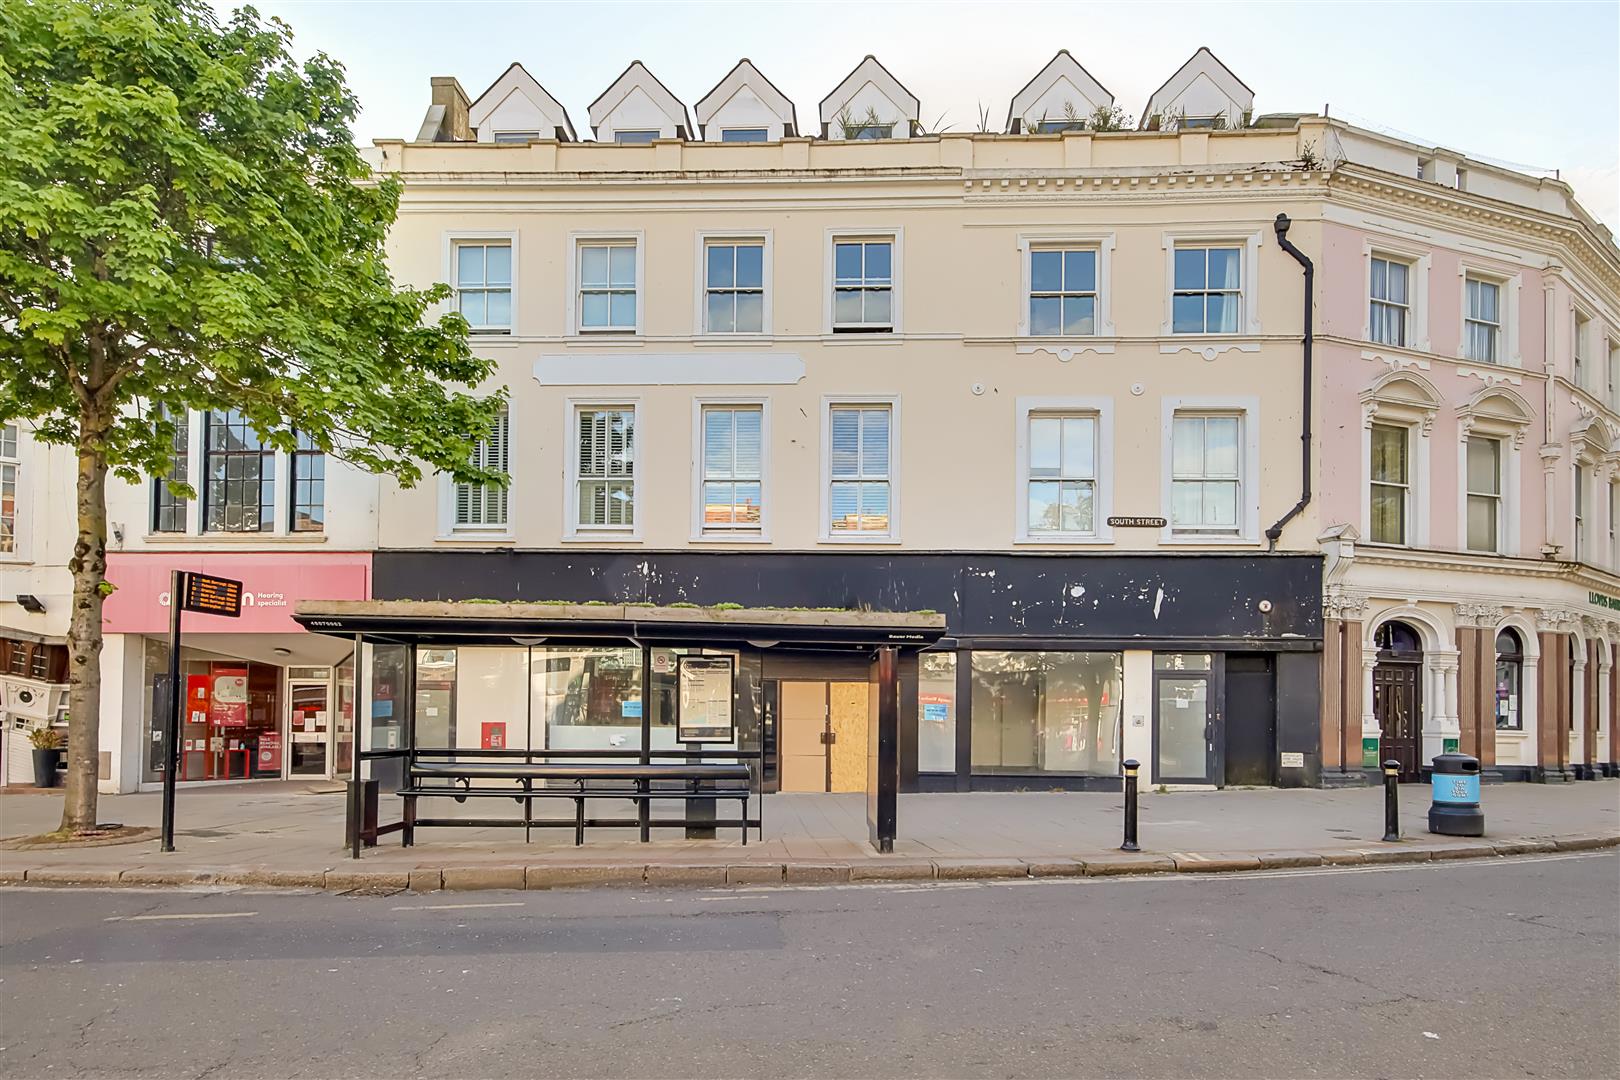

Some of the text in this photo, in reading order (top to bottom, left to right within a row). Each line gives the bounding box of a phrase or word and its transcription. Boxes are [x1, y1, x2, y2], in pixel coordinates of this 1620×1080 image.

[1136, 518, 1164, 526] STREET
[257, 592, 284, 600] Hearing
[1588, 591, 1608, 608] LLOYDS
